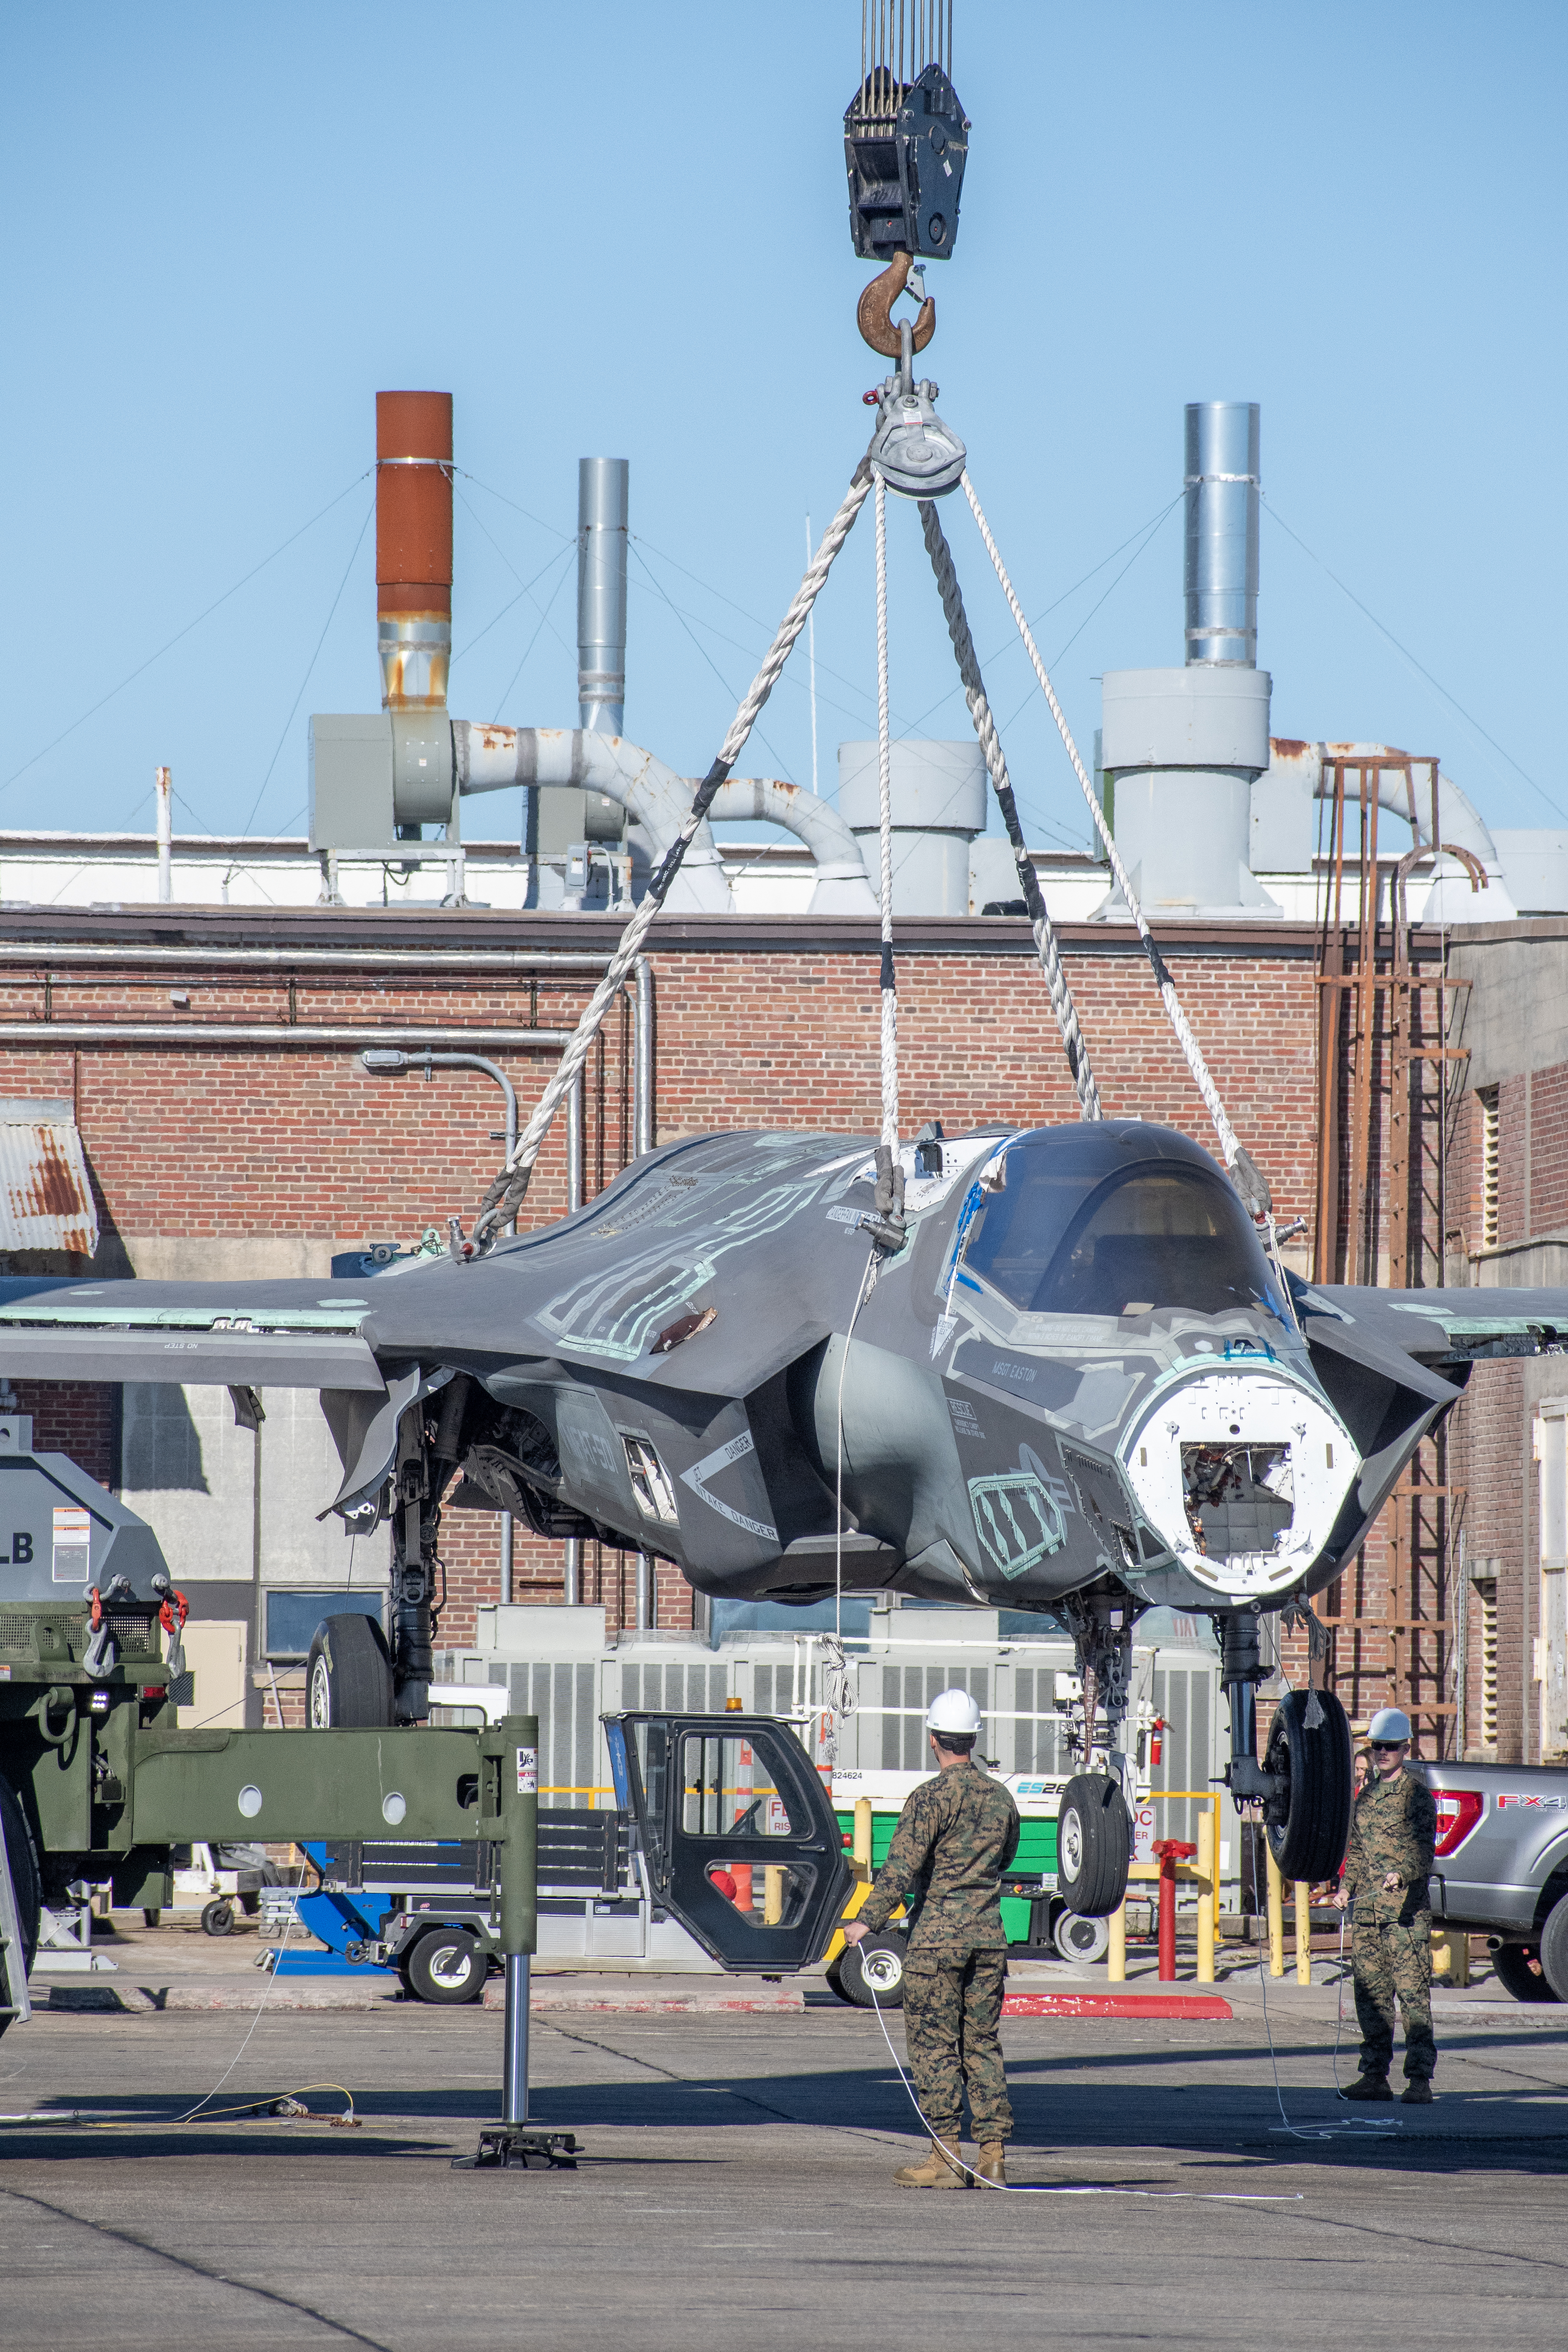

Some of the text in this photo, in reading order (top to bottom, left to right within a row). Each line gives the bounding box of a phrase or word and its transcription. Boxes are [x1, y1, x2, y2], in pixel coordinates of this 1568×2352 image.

[685, 1302, 696, 1310] STEP
[938, 1320, 953, 1329] EJECTION
[938, 1330, 954, 1356] DANGER
[992, 1361, 1037, 1383] MSGT EASTON
[949, 1400, 973, 1417] RESCUE
[692, 1435, 752, 1482] JET DANGER
[695, 1483, 776, 1539] INTAKE DANGER
[1497, 1794, 1567, 1809] FX4
